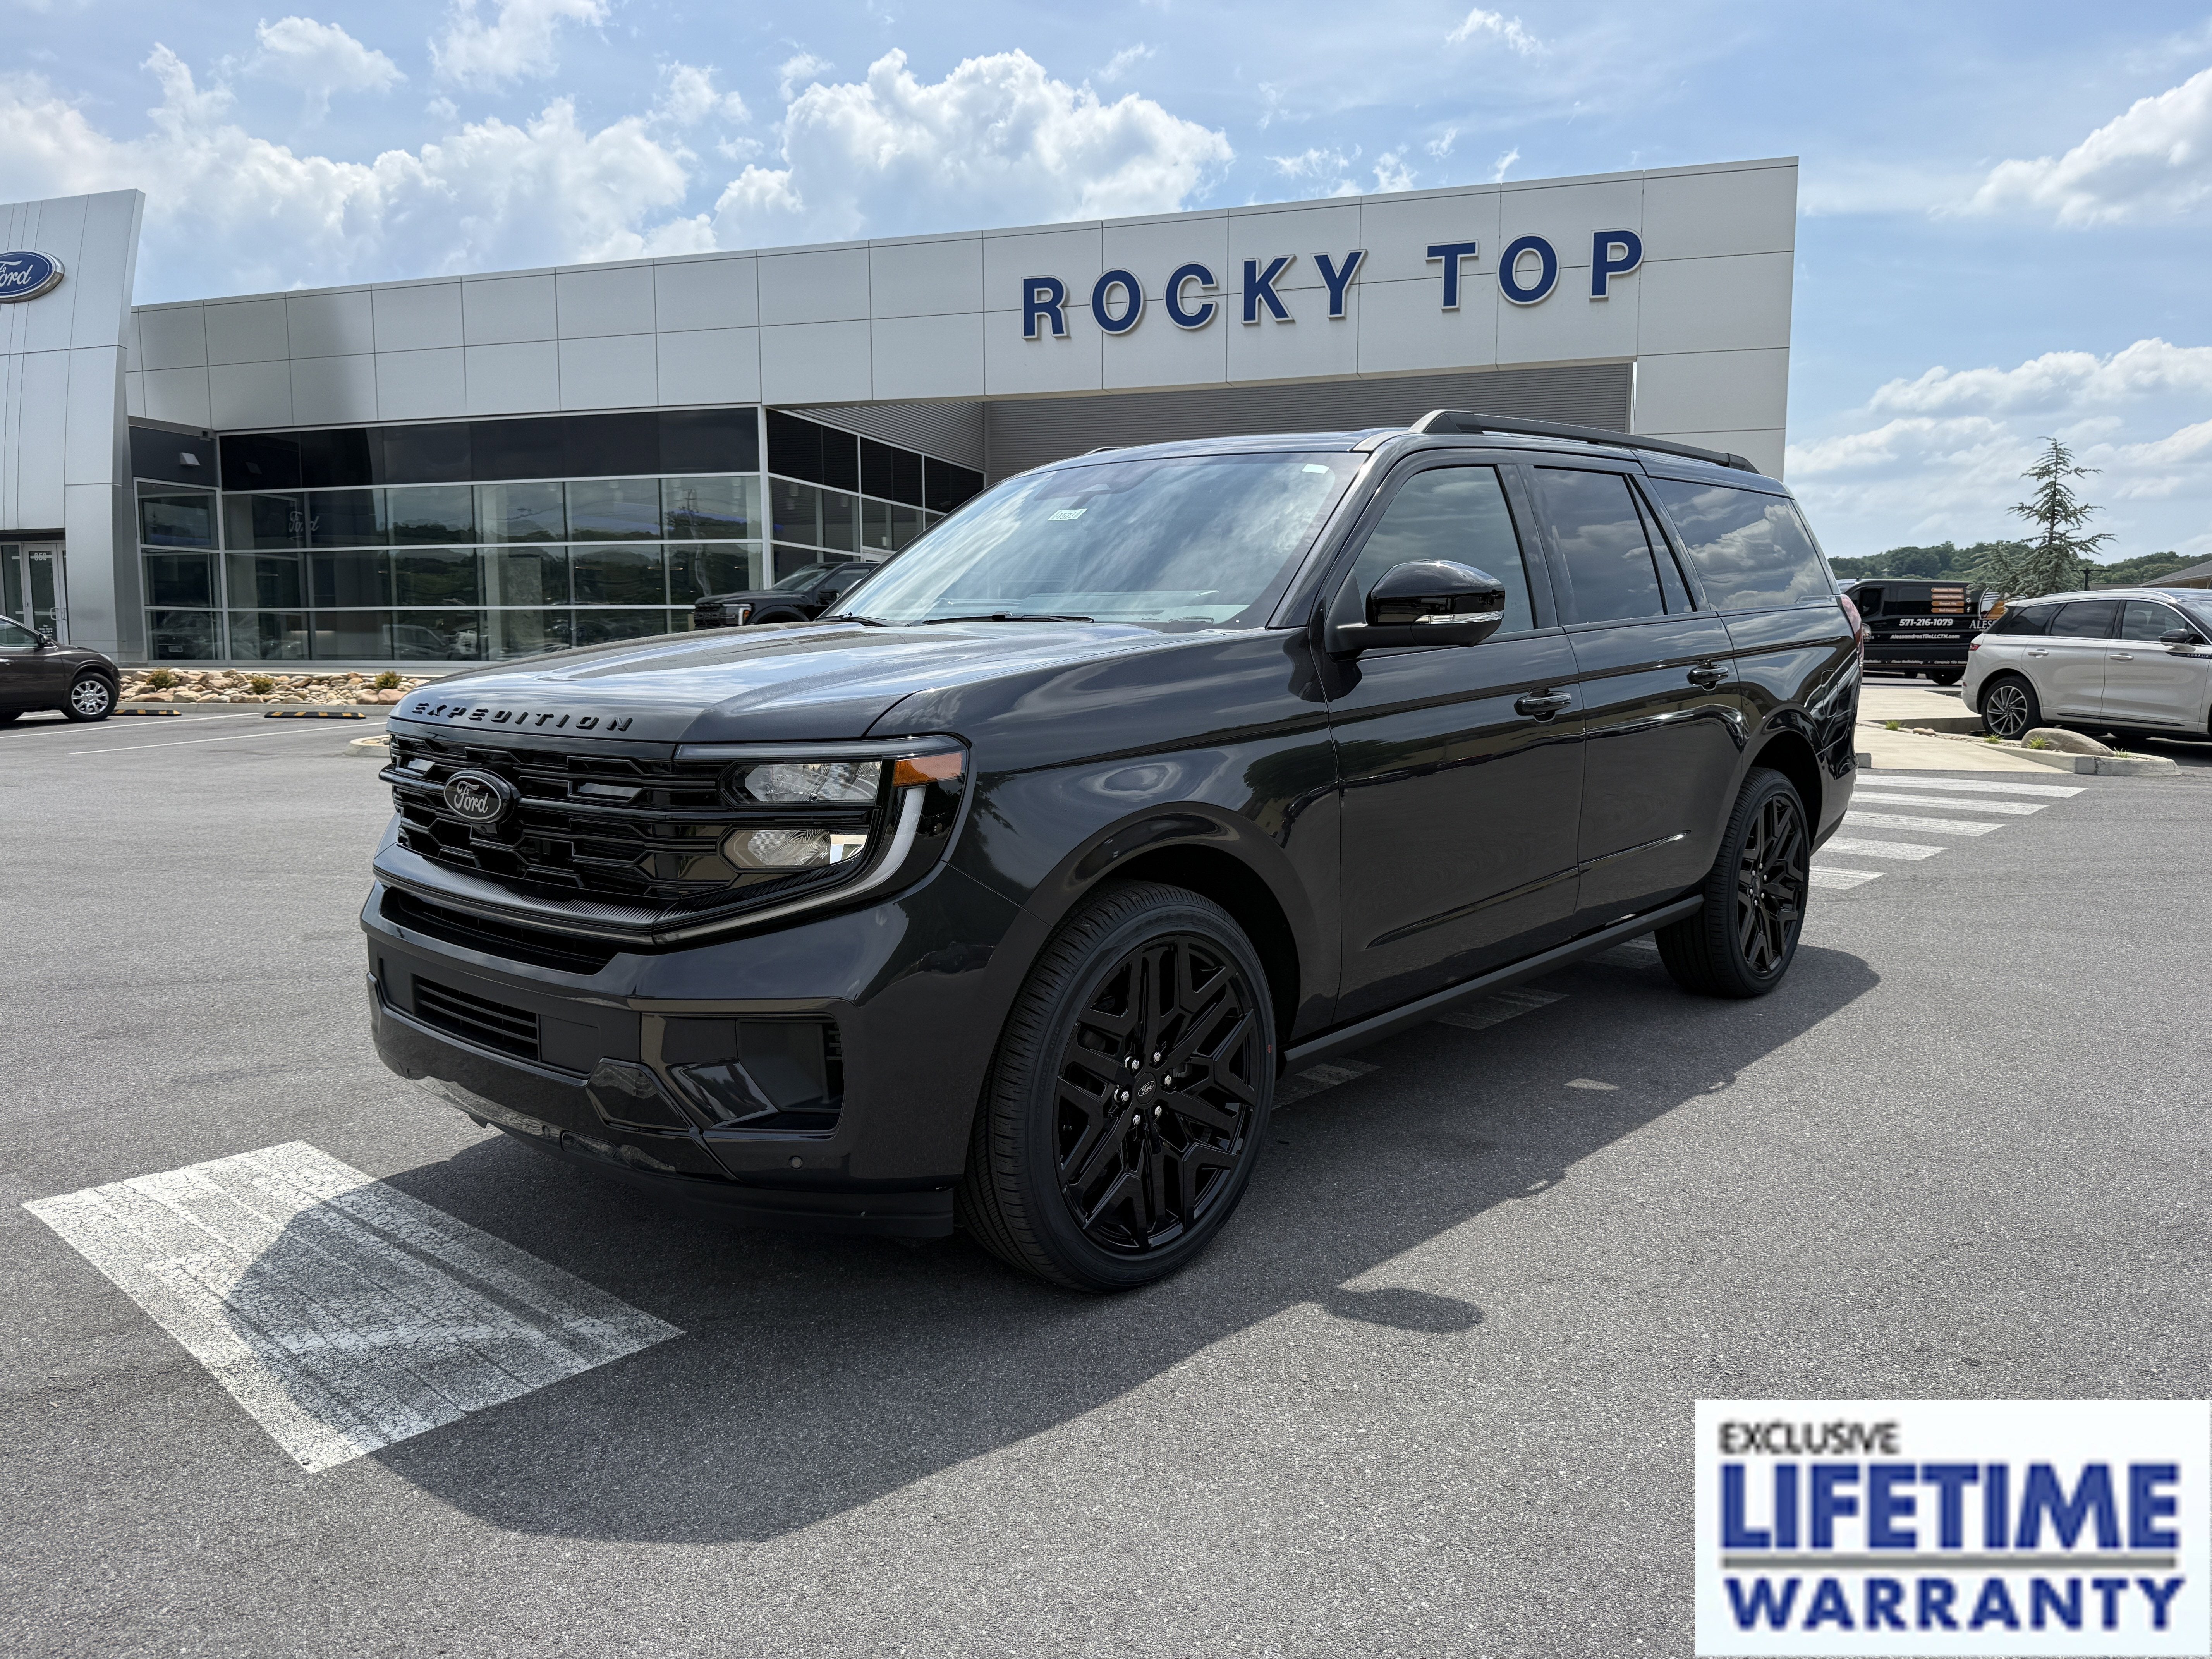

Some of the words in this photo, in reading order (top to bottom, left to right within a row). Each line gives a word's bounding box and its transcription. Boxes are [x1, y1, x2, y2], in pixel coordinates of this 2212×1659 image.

[1022, 249, 1367, 339] ROCKY
[1425, 228, 1644, 311] TOP
[412, 703, 633, 732] EXPEDITION
[454, 781, 489, 814] Ford
[1141, 1083, 1152, 1095] Ford
